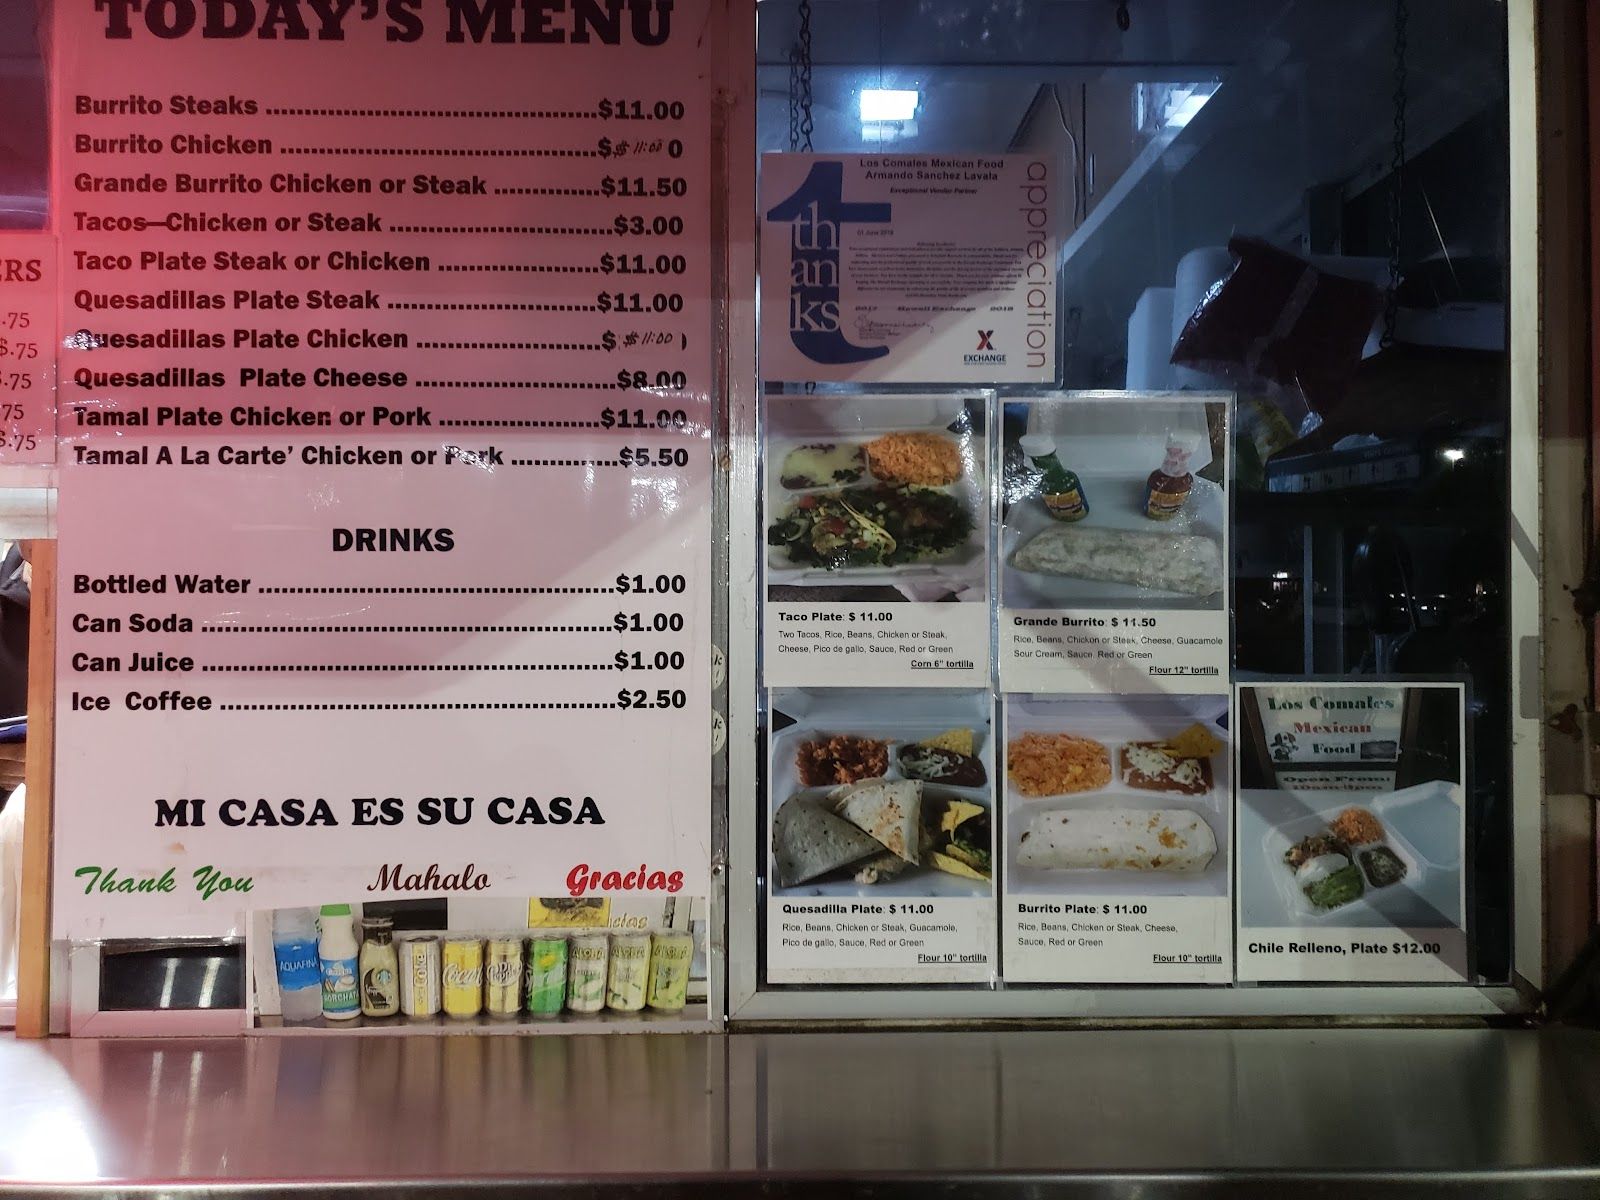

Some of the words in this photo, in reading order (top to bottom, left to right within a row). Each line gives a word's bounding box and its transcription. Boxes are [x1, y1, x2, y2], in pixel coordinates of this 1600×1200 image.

[95, 0, 424, 42] TODAY'S
[446, 0, 674, 46] MENU
[75, 95, 162, 114] Burrito
[170, 95, 258, 115] Steaks
[598, 98, 685, 120] $11.00
[75, 134, 163, 154] Burrito
[170, 134, 273, 154] Chicken
[860, 158, 879, 168] Los
[931, 159, 975, 169] Mexican
[977, 159, 1004, 169] Food
[865, 170, 912, 180] Armando
[917, 170, 960, 181] Sanchez
[964, 171, 998, 181] Lavala
[74, 173, 167, 193] Grande
[175, 174, 262, 193] Burrito
[270, 174, 371, 194] Chicken
[379, 179, 405, 194] or
[412, 174, 487, 195] Steak
[600, 176, 687, 197] $11.50
[275, 218, 301, 232] or
[307, 212, 383, 232] Steak
[613, 215, 684, 236] $3.00
[73, 251, 131, 271] Taco
[141, 251, 207, 271] Plate
[213, 251, 287, 271] Steak
[295, 256, 320, 271] or
[327, 251, 430, 272] Chicken
[600, 253, 686, 275] $11.00
[1020, 161, 1052, 368] appreciation
[74, 290, 226, 310] Quesadillas
[233, 290, 299, 310] Plate
[306, 290, 380, 310] Steak
[597, 292, 683, 313] $11.00
[233, 329, 299, 349] Plate
[307, 329, 408, 349] Chicken
[964, 354, 1007, 363] EXCHANGE
[74, 368, 225, 388] Quesadillas
[240, 368, 306, 388] Plate
[314, 368, 407, 388] Cheese
[617, 370, 687, 391] $8.00
[74, 407, 148, 426] Tamal
[157, 407, 222, 426] Plate
[230, 406, 331, 427] Chicken
[340, 412, 365, 426] or
[373, 406, 431, 427] Pork
[600, 408, 687, 430] $11.00
[74, 446, 148, 465] Tamal
[156, 446, 173, 465] A
[181, 446, 210, 465] La
[302, 445, 402, 466] Chicken
[411, 451, 437, 466] or
[619, 447, 688, 468] $5.50
[332, 528, 454, 552] DRINKS
[74, 575, 167, 594] Bottled
[175, 575, 251, 594] Water
[615, 573, 686, 595] $1.00
[72, 614, 121, 633] Can
[128, 614, 193, 633] Soda
[613, 612, 684, 632] $1.00
[779, 612, 808, 622] Taco
[811, 612, 845, 622] Plate:
[860, 612, 893, 622] 11.00
[1014, 617, 1058, 627] Grande
[1123, 617, 1156, 627] 11.50
[779, 631, 795, 639] Two
[798, 631, 822, 640] Tacos,
[825, 631, 845, 640] Rice,
[848, 631, 874, 640] Beans,
[877, 631, 909, 639] Chicken
[1014, 635, 1033, 645] Rice,
[1067, 635, 1100, 645] Chicken
[1177, 636, 1223, 645] Guacamole
[814, 645, 831, 654] Pico
[869, 645, 897, 655] Sauce,
[899, 645, 916, 653] Red
[928, 645, 954, 654] Green
[1014, 650, 1033, 658] Sour
[1098, 650, 1114, 658] Red
[1127, 650, 1153, 659] Green
[72, 653, 120, 672] Can
[128, 652, 194, 672] Juice
[614, 651, 685, 671] $1.00
[911, 659, 932, 669] Corn
[946, 659, 974, 669] tortilla
[1149, 666, 1172, 675] Flour
[1191, 666, 1219, 675] tortilla
[72, 692, 110, 711] Ice
[125, 691, 212, 711] Coffee
[617, 688, 686, 709] $2.50
[1267, 697, 1303, 710] Los
[1310, 696, 1394, 710] Comales
[1294, 721, 1371, 734] Mexican
[1313, 743, 1356, 754] Food
[155, 799, 206, 827] MI
[218, 799, 338, 827] CASA
[352, 798, 404, 826] ES
[417, 797, 474, 825] SU
[487, 797, 606, 825] CASA
[75, 865, 177, 895] Thank
[192, 864, 255, 901] You
[366, 863, 492, 892] Mahalo
[566, 863, 685, 897] Gracias
[782, 904, 847, 914] Quesadilla
[900, 904, 934, 914] 11.00
[1018, 904, 1061, 914] Burrito
[1114, 904, 1147, 914] 11.00
[782, 923, 802, 932] Rice,
[836, 923, 869, 932] Chicken
[881, 923, 907, 933] Steak,
[909, 924, 958, 933] Guacamole,
[1018, 923, 1038, 932] Rice,
[1041, 923, 1068, 932] Beans,
[1071, 923, 1104, 932] Chicken
[782, 938, 800, 947] Pico
[839, 938, 866, 948] Sauce,
[869, 938, 886, 947] Red
[899, 938, 924, 947] Green
[1018, 938, 1046, 947] Sauce,
[1048, 938, 1065, 947] Red
[1078, 938, 1103, 947] Green
[1249, 943, 1284, 954] Chile
[1289, 943, 1346, 956] Relleno,
[1351, 943, 1388, 954] Plate
[1392, 943, 1440, 955] $12.00
[918, 953, 941, 963] Flour
[960, 953, 987, 963] tortilla
[1153, 953, 1175, 963] Flour
[1195, 953, 1222, 963] tortilla
